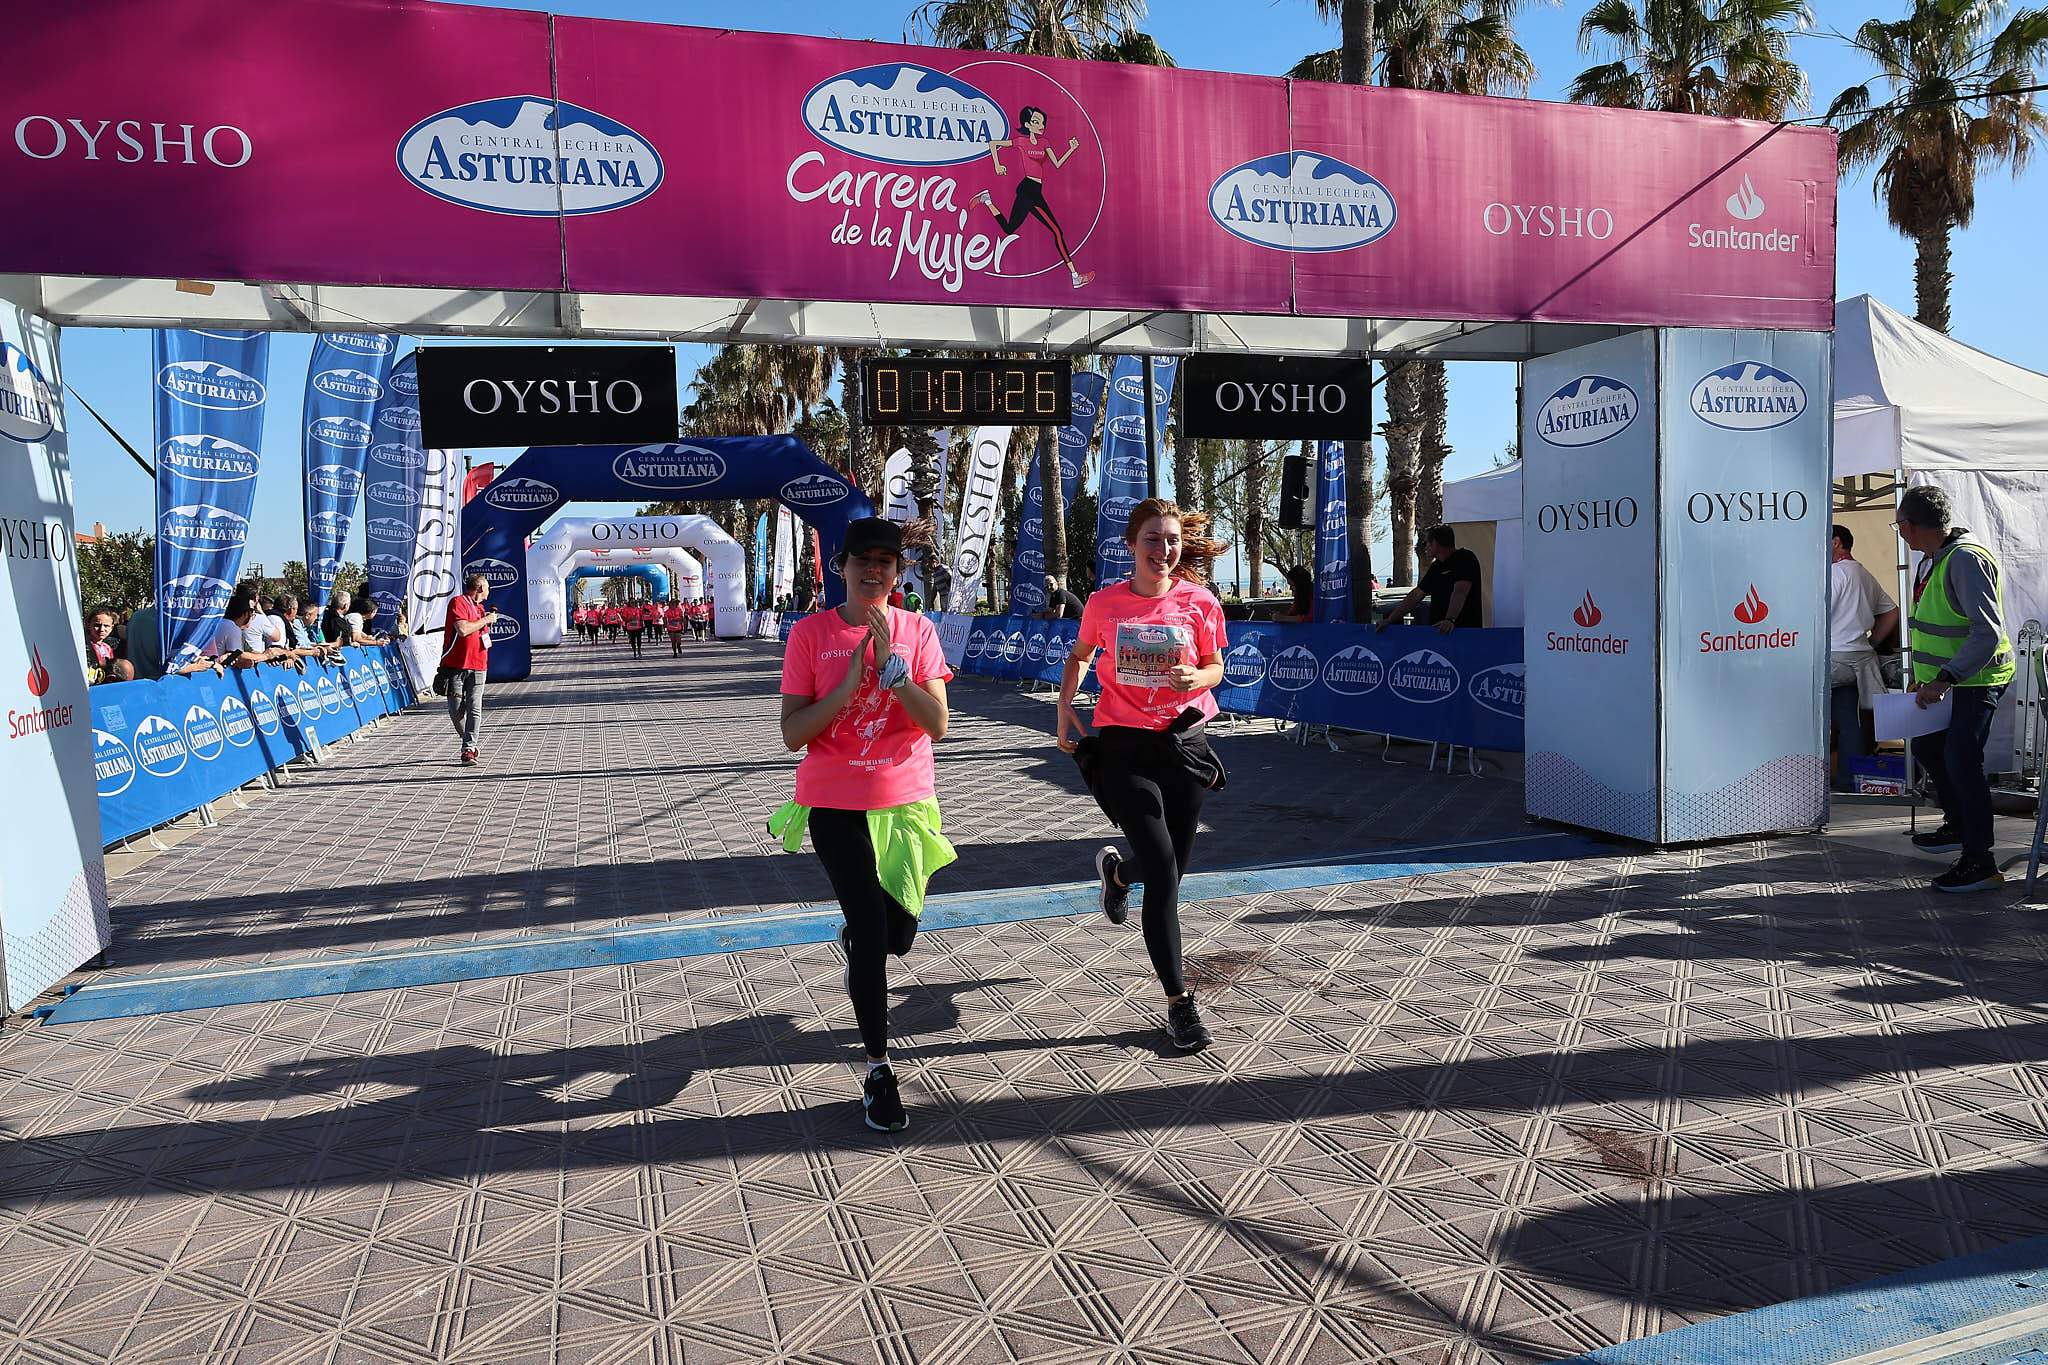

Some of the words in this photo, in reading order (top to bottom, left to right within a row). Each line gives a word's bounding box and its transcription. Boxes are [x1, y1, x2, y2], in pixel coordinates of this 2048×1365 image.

[850, 94, 917, 109] CENTRAL
[922, 100, 987, 114] LECHERA
[819, 94, 992, 144] ASTURIANA
[14, 114, 254, 169] OYSHO
[460, 135, 544, 149] CENTRAL
[420, 135, 645, 188] ASTURIANA
[786, 151, 958, 212] Carrera
[1252, 183, 1312, 196] CENTRAL
[1317, 187, 1376, 199] LECHERA
[1223, 183, 1383, 229] ASTURIANA
[1483, 202, 1615, 240] OYSHO
[830, 209, 863, 246] de
[870, 209, 892, 248] la
[888, 207, 1020, 293] Mujer
[1688, 223, 1800, 253] Santander
[165, 370, 258, 402] ASTURIANA
[463, 378, 643, 415] OYSHO
[877, 369, 1056, 413] 01:01:26
[1215, 381, 1347, 414] OYSHO
[1557, 400, 1589, 412] CENTRAL
[1591, 393, 1628, 406] LECHERA
[1698, 387, 1799, 414] ASTURIANA
[1542, 403, 1631, 435] ASTURIANA
[164, 444, 254, 474] ASTURIANA
[621, 457, 718, 478] ASTURIANA
[489, 491, 553, 504] ASTURIANA
[786, 485, 845, 500] ASTURIANA
[957, 439, 1001, 578] OYSHO
[1538, 497, 1638, 533] OYSHO
[1687, 490, 1808, 524] OYSHO
[0, 516, 66, 562] YSHO
[161, 517, 246, 542] ASTURIANA
[591, 522, 679, 541] OYSHO
[538, 543, 567, 551] OYSHO
[528, 578, 555, 586] OYSHO
[529, 613, 556, 621] OYSHO
[1547, 631, 1629, 654] Santander
[1699, 628, 1799, 653] Santander
[1224, 659, 1263, 677] ASTURIANA
[1271, 661, 1315, 680] ASTURIANA
[1326, 662, 1378, 684] ASTURIANA
[1392, 666, 1451, 692] ASTURIANA
[1475, 677, 1524, 705] ASTU
[8, 700, 73, 740] Santander
[139, 739, 186, 766] ASTURIANA
[1860, 783, 1891, 794] Carrera
